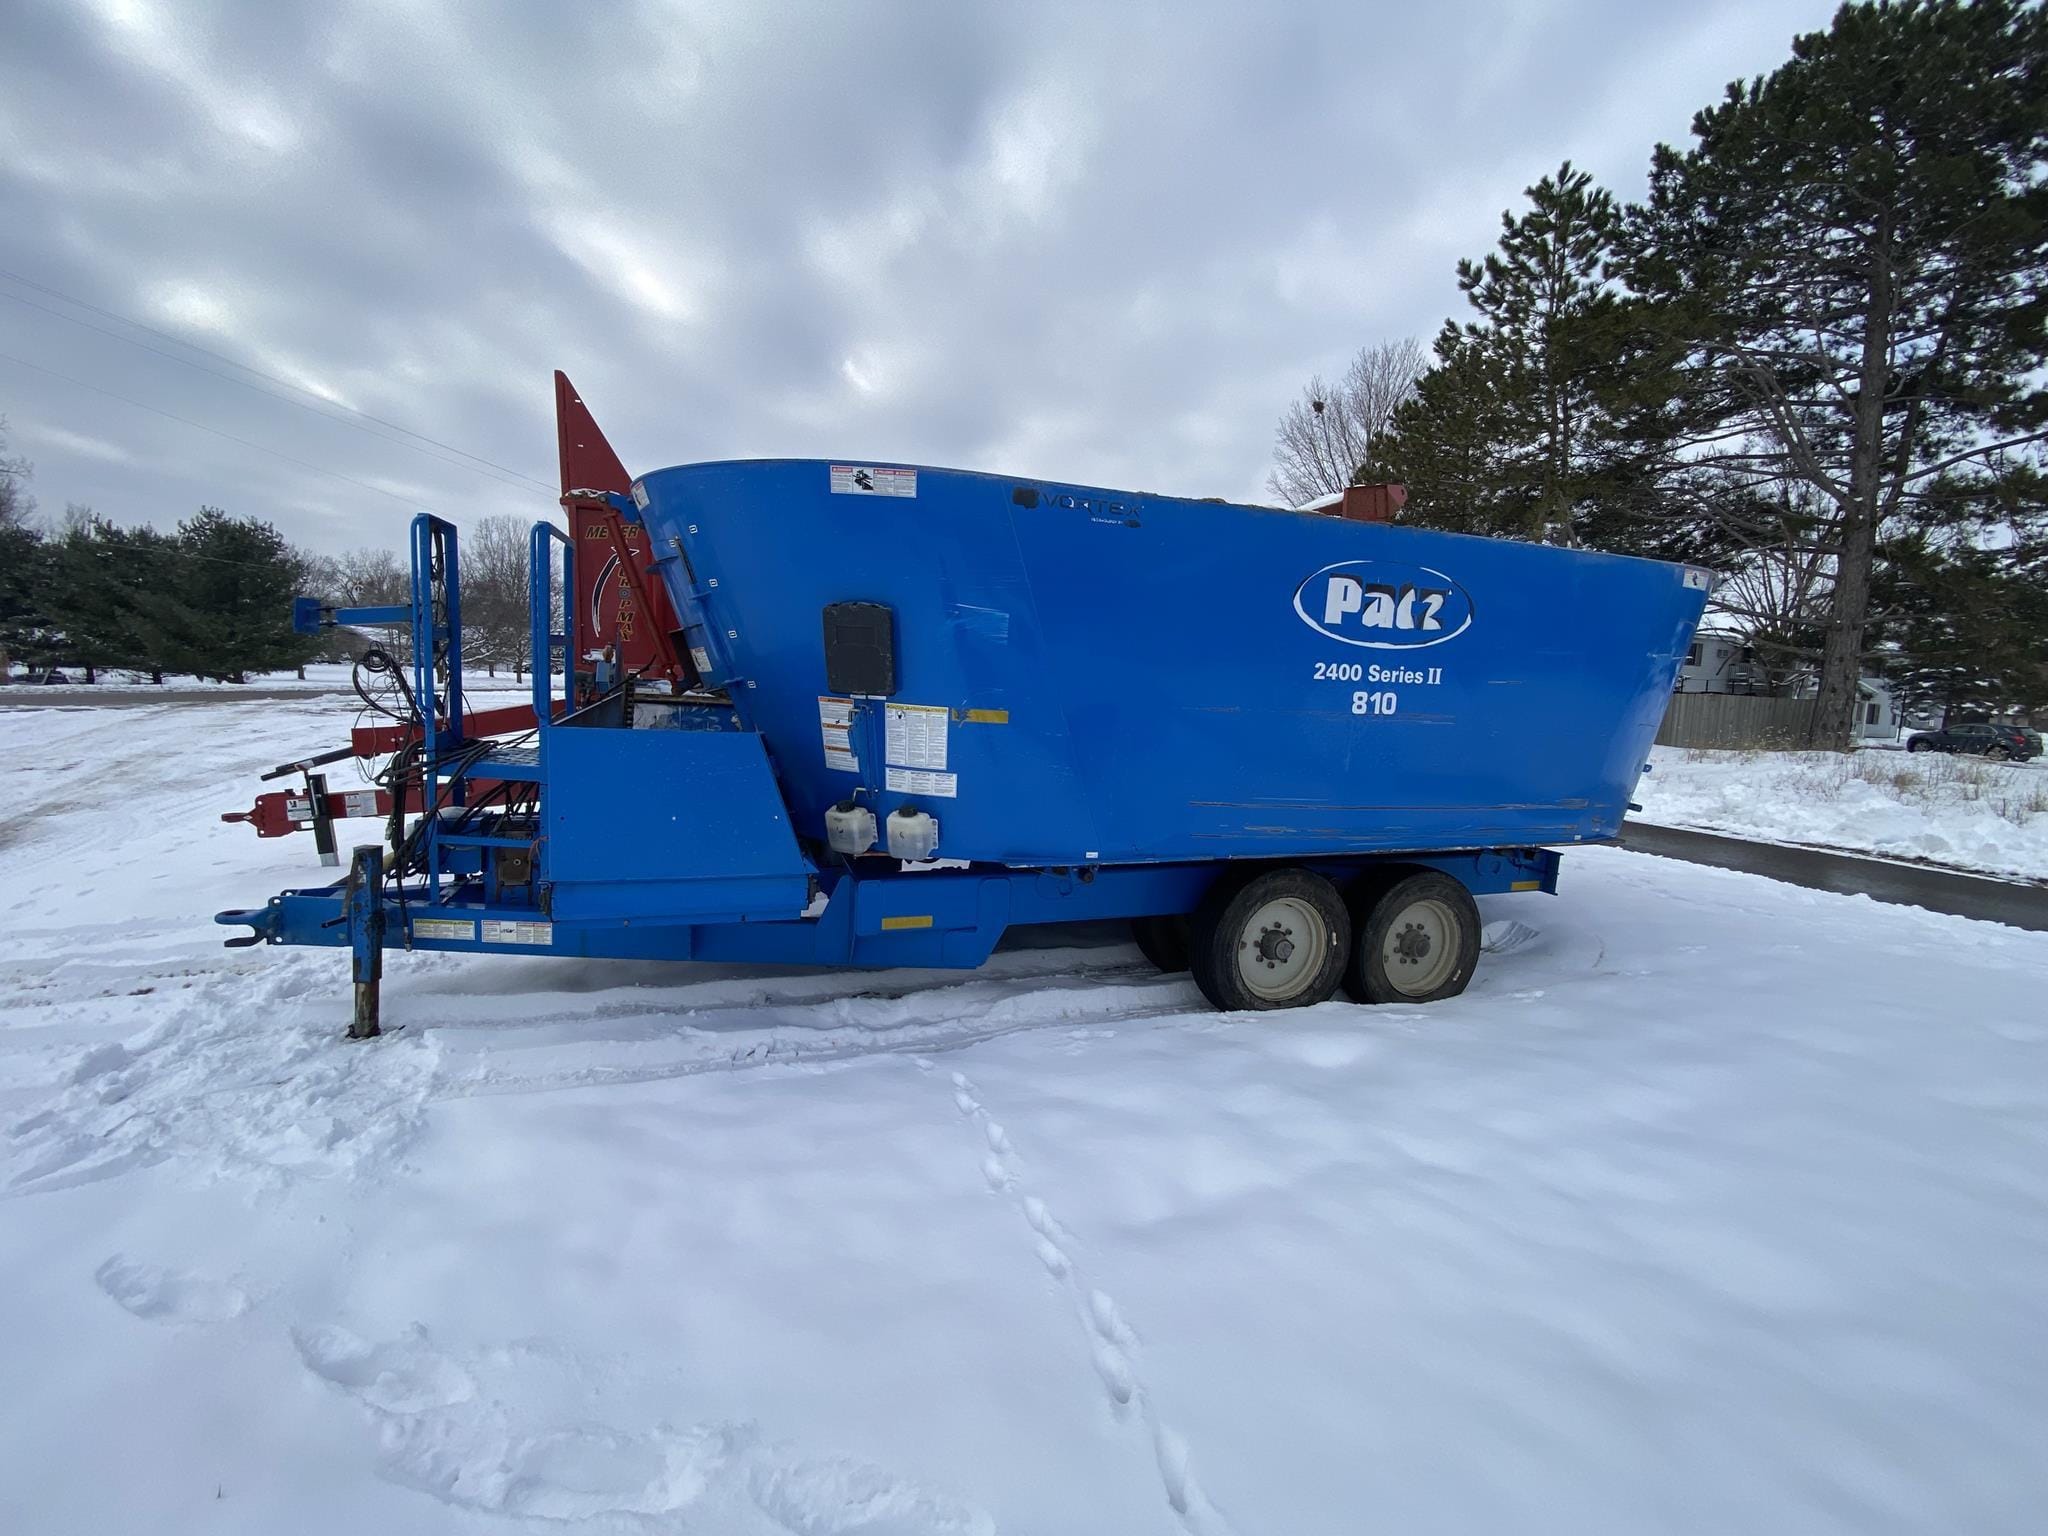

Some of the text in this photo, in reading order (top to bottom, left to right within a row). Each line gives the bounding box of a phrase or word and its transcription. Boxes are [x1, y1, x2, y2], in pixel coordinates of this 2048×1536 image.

[585, 525, 639, 539] MEER
[1324, 573, 1447, 631] Patz
[1313, 662, 1443, 685] 2400 Series II
[1351, 691, 1397, 715] 810
